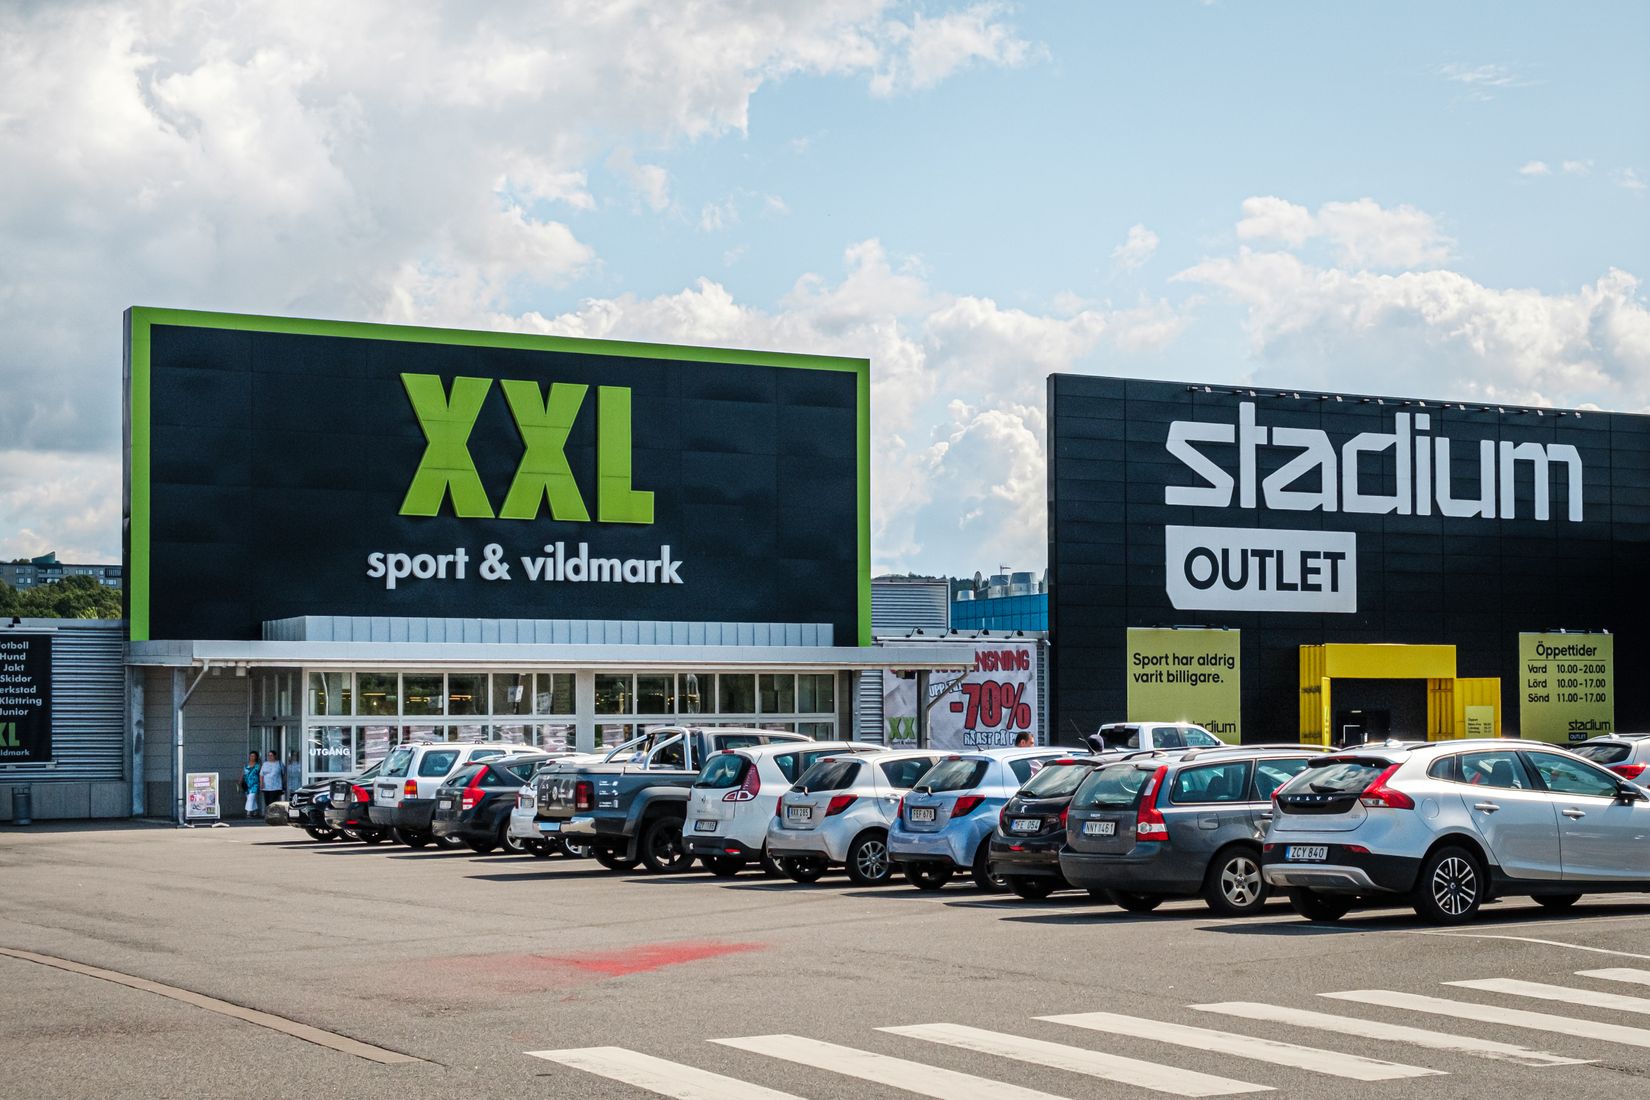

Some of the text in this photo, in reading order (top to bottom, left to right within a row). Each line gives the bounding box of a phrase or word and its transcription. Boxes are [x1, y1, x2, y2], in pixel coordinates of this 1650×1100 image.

[398, 372, 654, 524] XXL
[1165, 402, 1583, 522] stadium
[366, 541, 684, 589] sport & vildmark
[1184, 546, 1346, 593] OUTLET
[0, 641, 29, 650] otboll
[1536, 641, 1597, 659] Öppettider
[0, 652, 26, 660] Hund
[1133, 652, 1235, 669] Sport har aldrig
[3, 663, 25, 672] Jakt
[1528, 664, 1547, 674] Vard
[0, 674, 32, 683] Skidor
[1133, 670, 1224, 686] varit billigare.
[1528, 679, 1547, 688] Lörd
[0, 685, 37, 694] erkstad
[0, 696, 43, 707] Klättring
[1528, 693, 1550, 703] Sönd
[949, 680, 1031, 730] -70%
[1568, 719, 1611, 731] stadium
[994, 729, 1007, 746] PÅ
[309, 746, 351, 756] UTGÅNG
[1027, 820, 1039, 829] 054
[1291, 847, 1324, 858] ZCY 840
